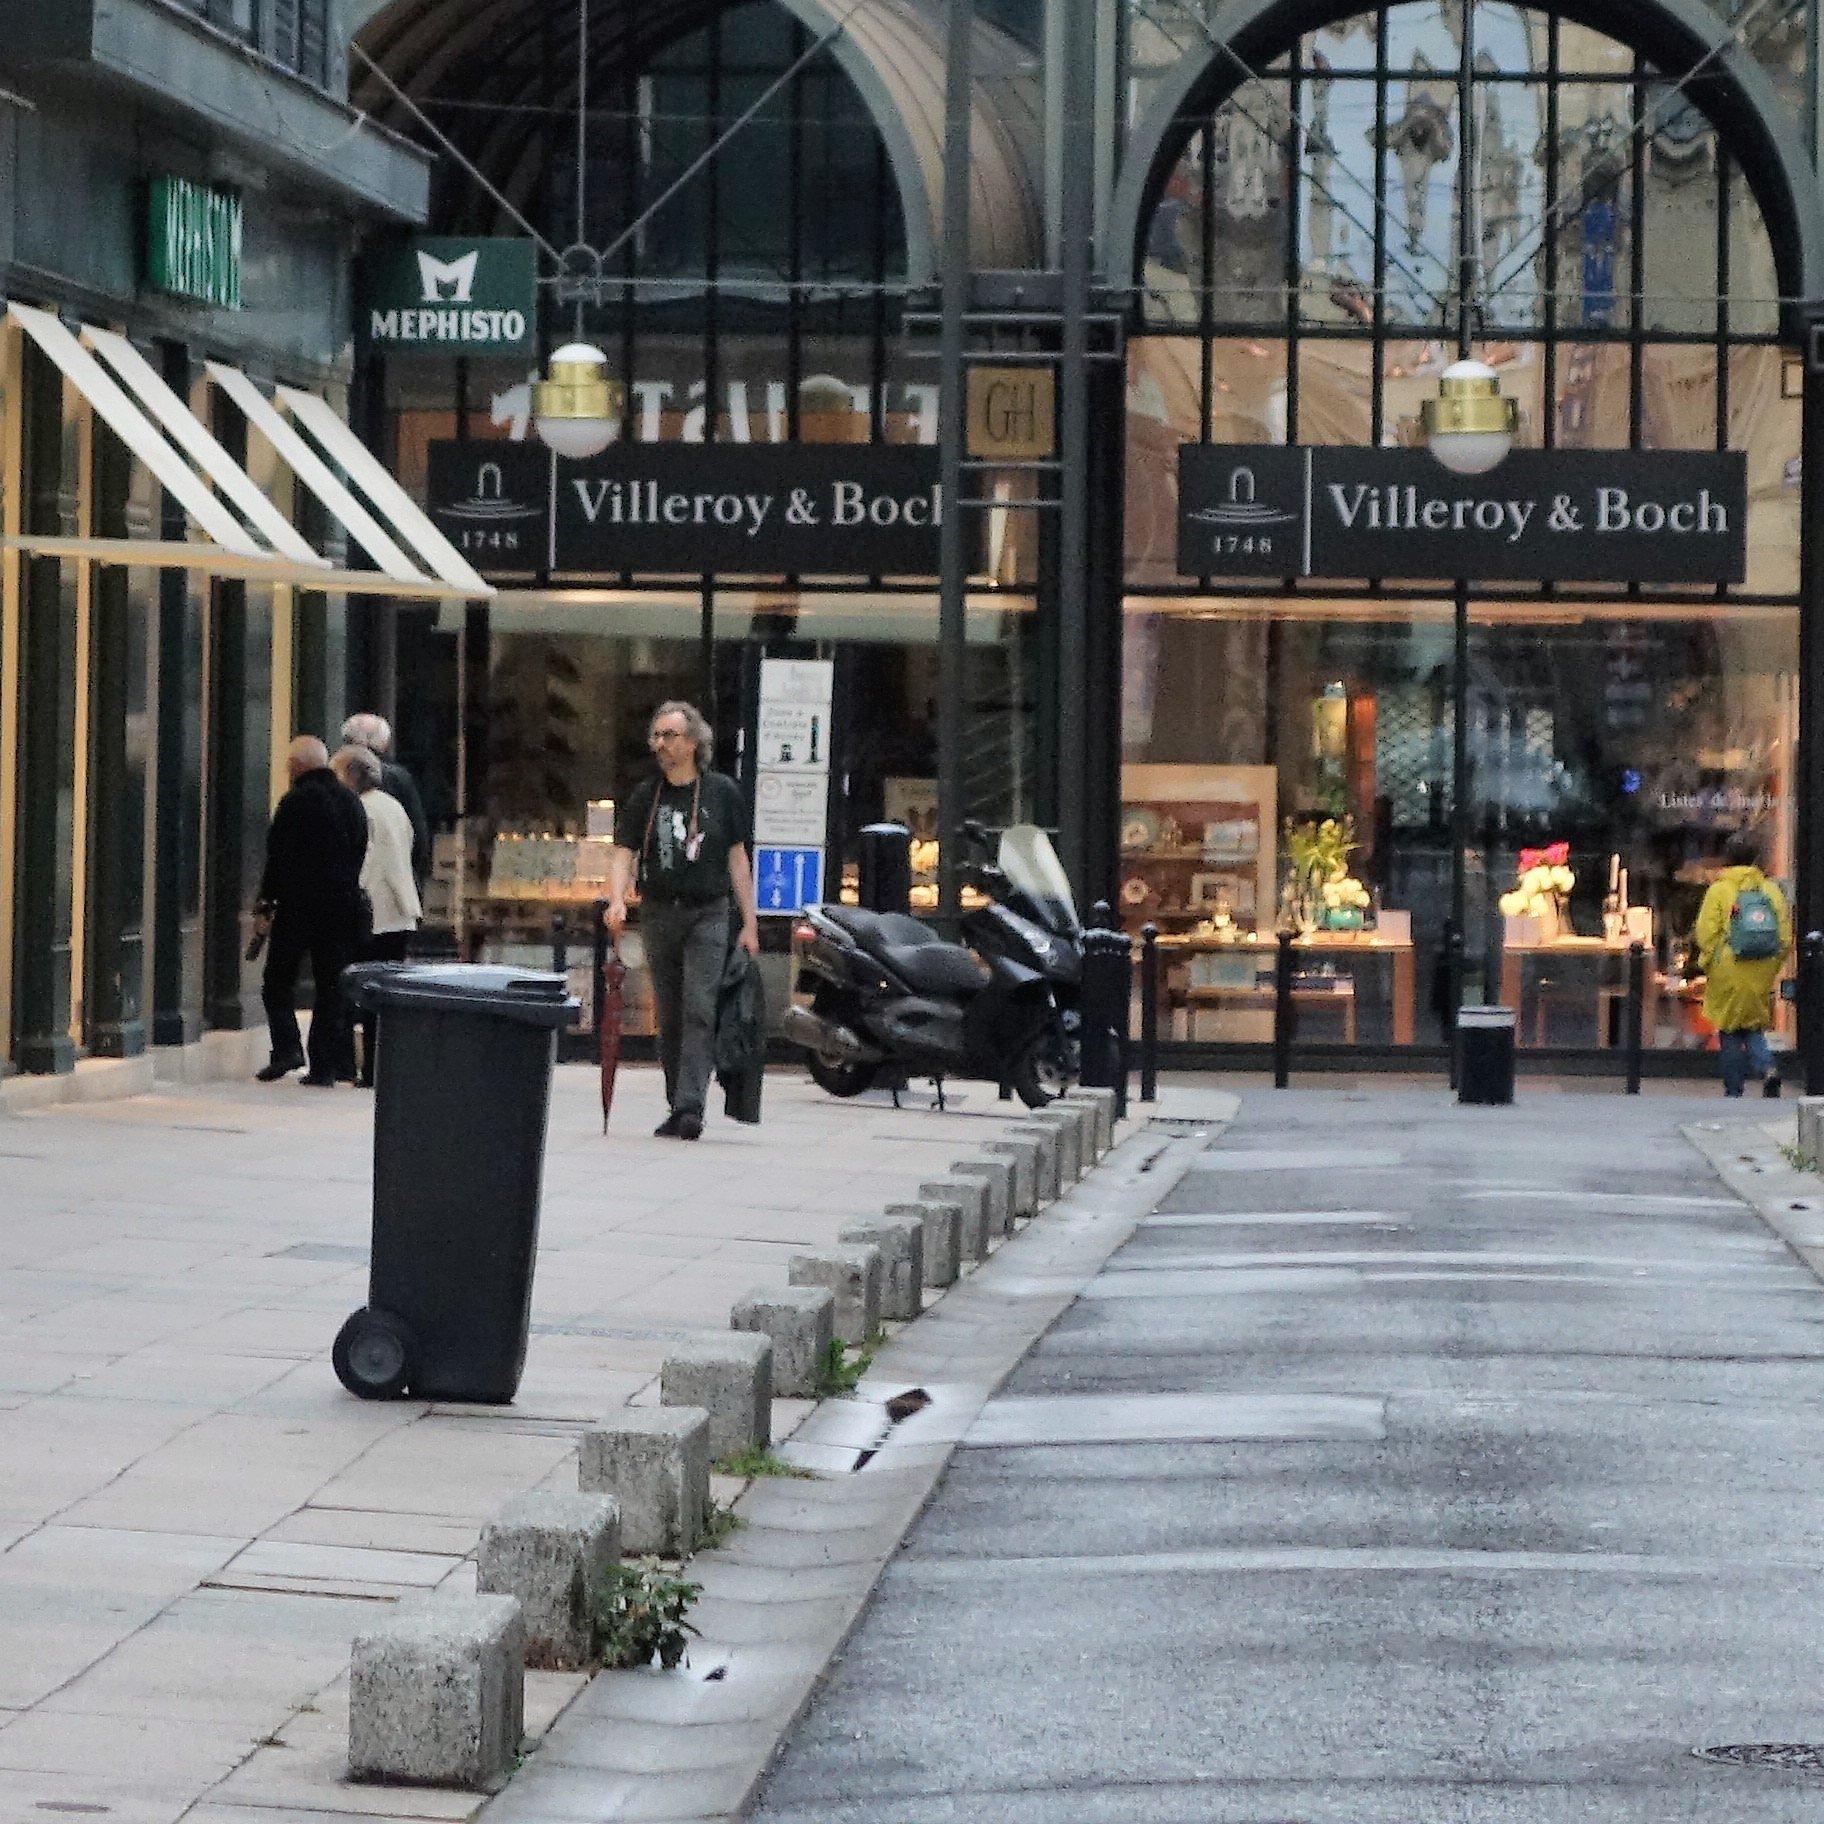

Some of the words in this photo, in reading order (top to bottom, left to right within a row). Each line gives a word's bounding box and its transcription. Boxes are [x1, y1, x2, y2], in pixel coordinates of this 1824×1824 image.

[370, 308, 526, 342] MEPHISTO
[572, 479, 774, 536] Villeroy
[786, 487, 820, 526] &
[1328, 483, 1537, 544] Villeroy
[1548, 494, 1586, 532] &
[1596, 486, 1730, 534] Boch
[461, 530, 520, 550] 1748
[1212, 535, 1274, 555] 1748
